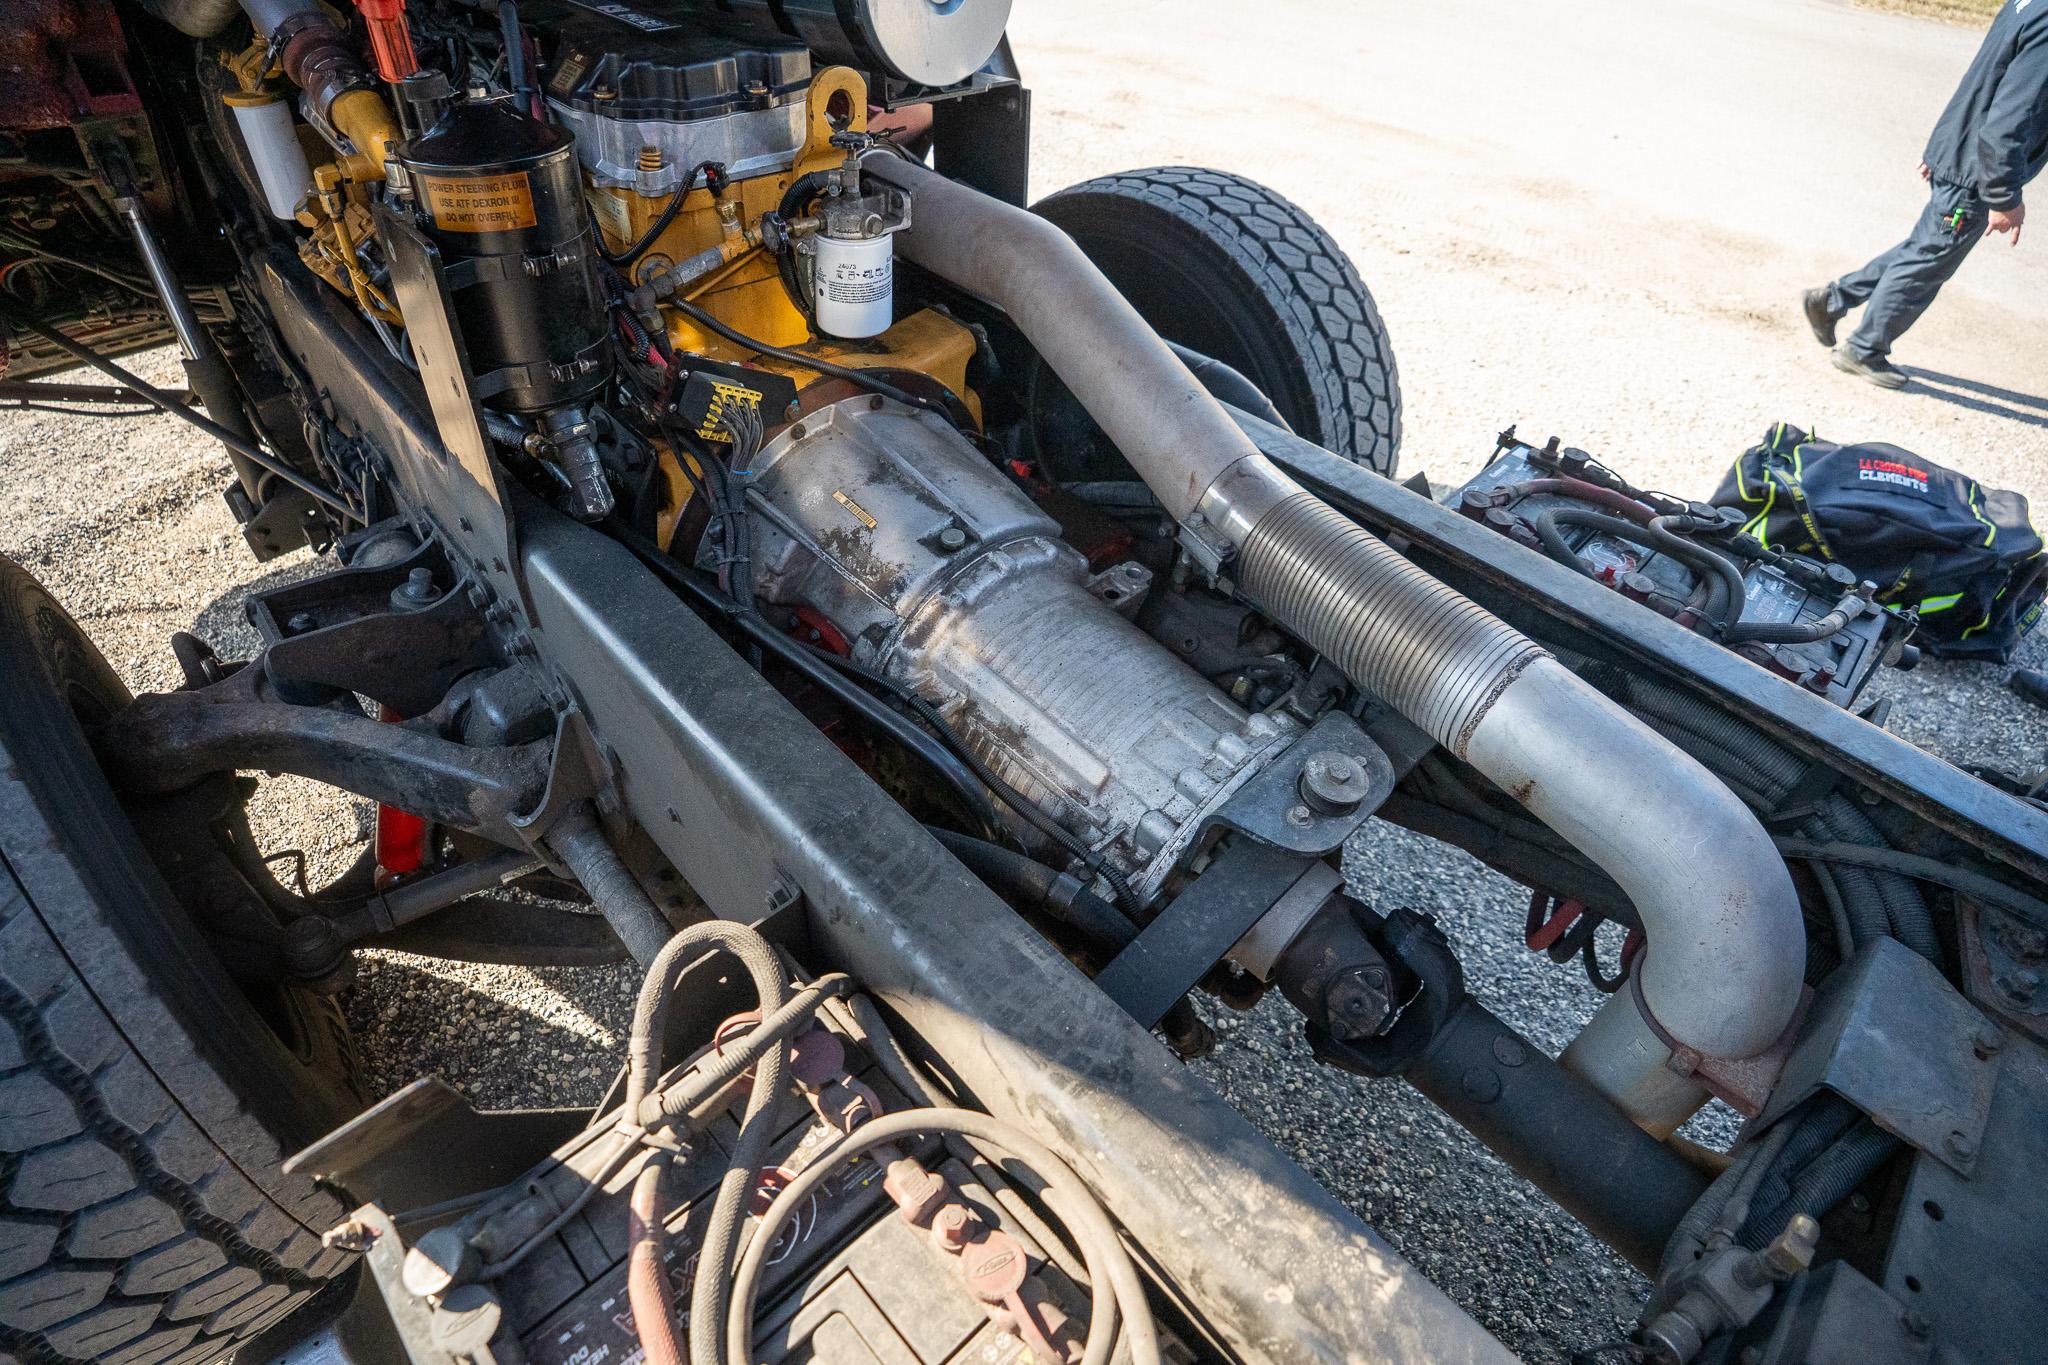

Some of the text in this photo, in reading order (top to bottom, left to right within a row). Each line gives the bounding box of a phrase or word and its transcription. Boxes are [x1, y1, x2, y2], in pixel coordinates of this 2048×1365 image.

[428, 179, 527, 193] POWER STEERING FLUID
[438, 198, 454, 208] USE
[456, 199, 471, 209] ATF
[473, 197, 510, 208] DEXRON
[445, 211, 520, 222] DO NOT OVERFILL
[1859, 458, 1873, 470] LA
[1859, 469, 1929, 493] CLEMENTS
